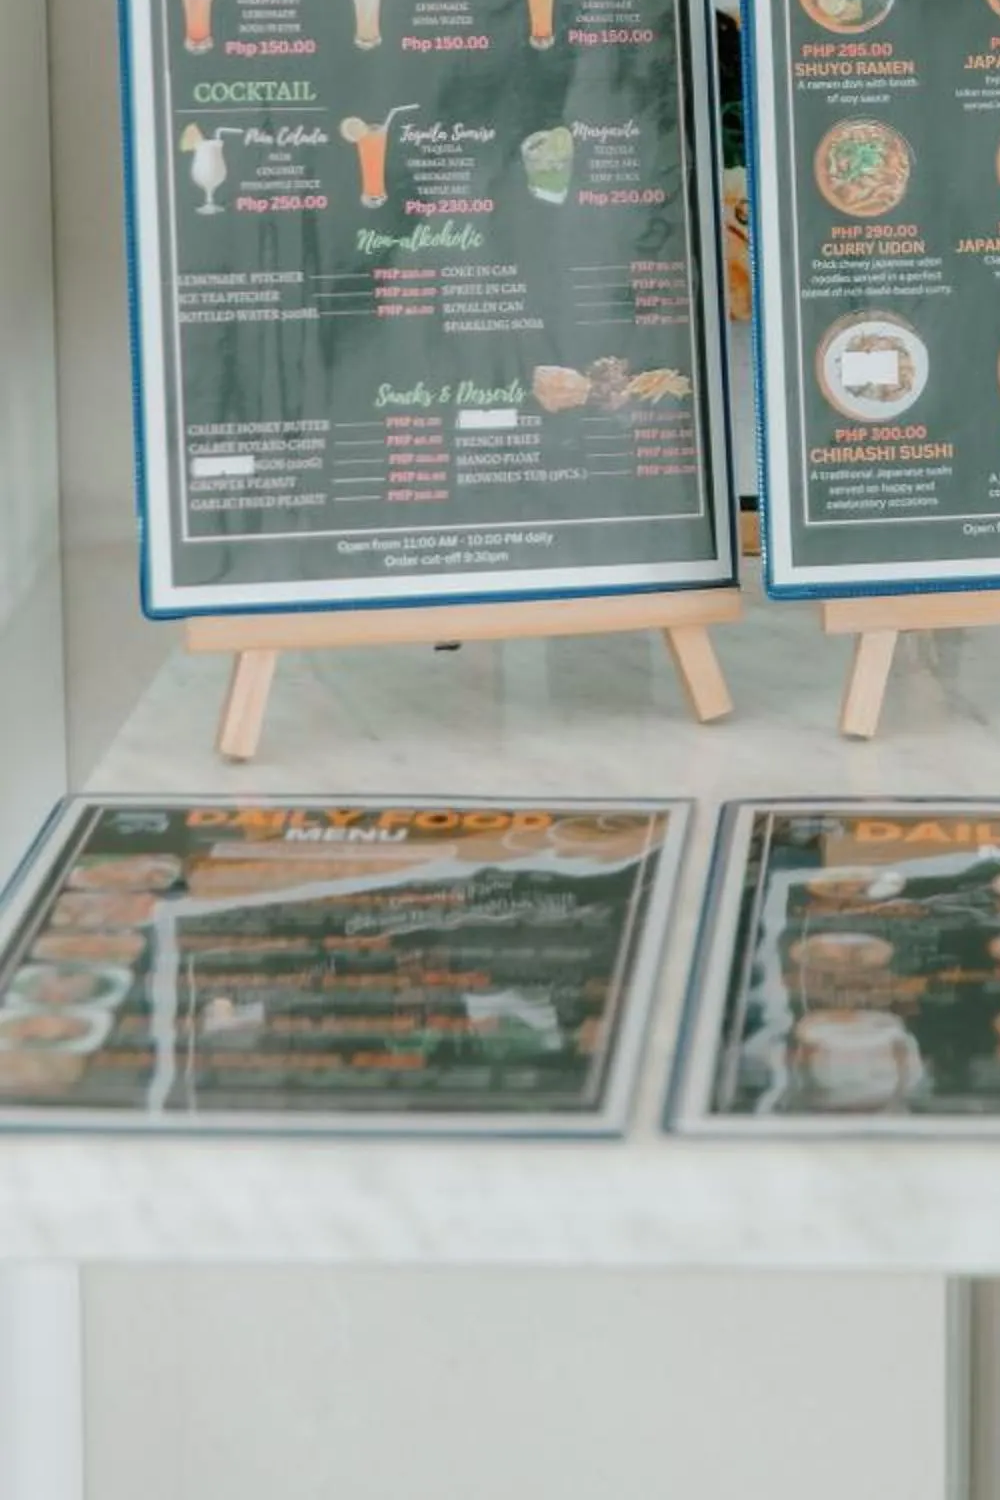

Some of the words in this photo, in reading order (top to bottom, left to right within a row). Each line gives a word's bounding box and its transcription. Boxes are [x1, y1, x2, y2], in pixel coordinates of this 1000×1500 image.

[401, 36, 432, 53] Php
[434, 34, 490, 50] 150.00
[568, 30, 599, 47] Php
[601, 27, 655, 45] 150.00
[225, 41, 257, 58] Php
[801, 43, 835, 58] PHP
[855, 60, 916, 77] RAMEN
[193, 80, 318, 102] COCKTAIL
[405, 200, 437, 217] Php
[832, 225, 864, 240] PHP
[821, 240, 876, 258] CURRY
[879, 239, 926, 256] UDON
[835, 427, 868, 443] PHP
[809, 444, 896, 464] CHIRASHI
[899, 442, 954, 460] SUSHI
[186, 808, 363, 828] DAILY
[377, 807, 554, 830] FOOD
[285, 826, 409, 841] MENU
